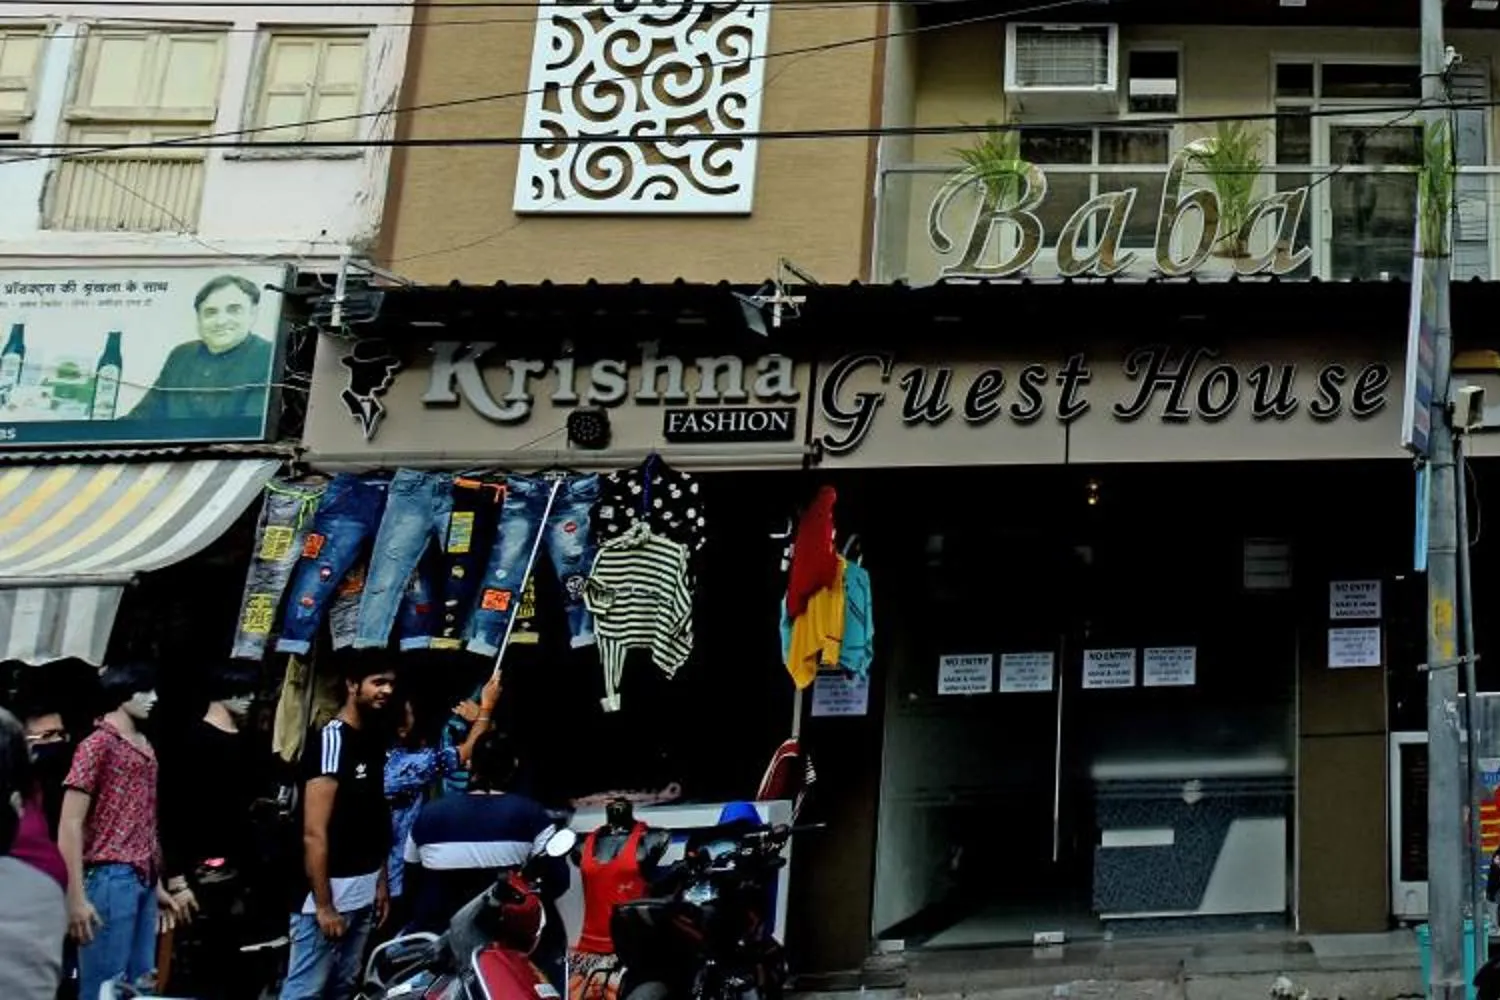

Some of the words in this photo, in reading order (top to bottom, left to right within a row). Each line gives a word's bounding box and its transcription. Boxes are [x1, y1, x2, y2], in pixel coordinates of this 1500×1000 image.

[928, 138, 1313, 277] Baba
[422, 341, 798, 423] Krishna
[666, 411, 790, 433] FASHION
[820, 351, 1092, 454] Guest
[1113, 346, 1391, 422] House
